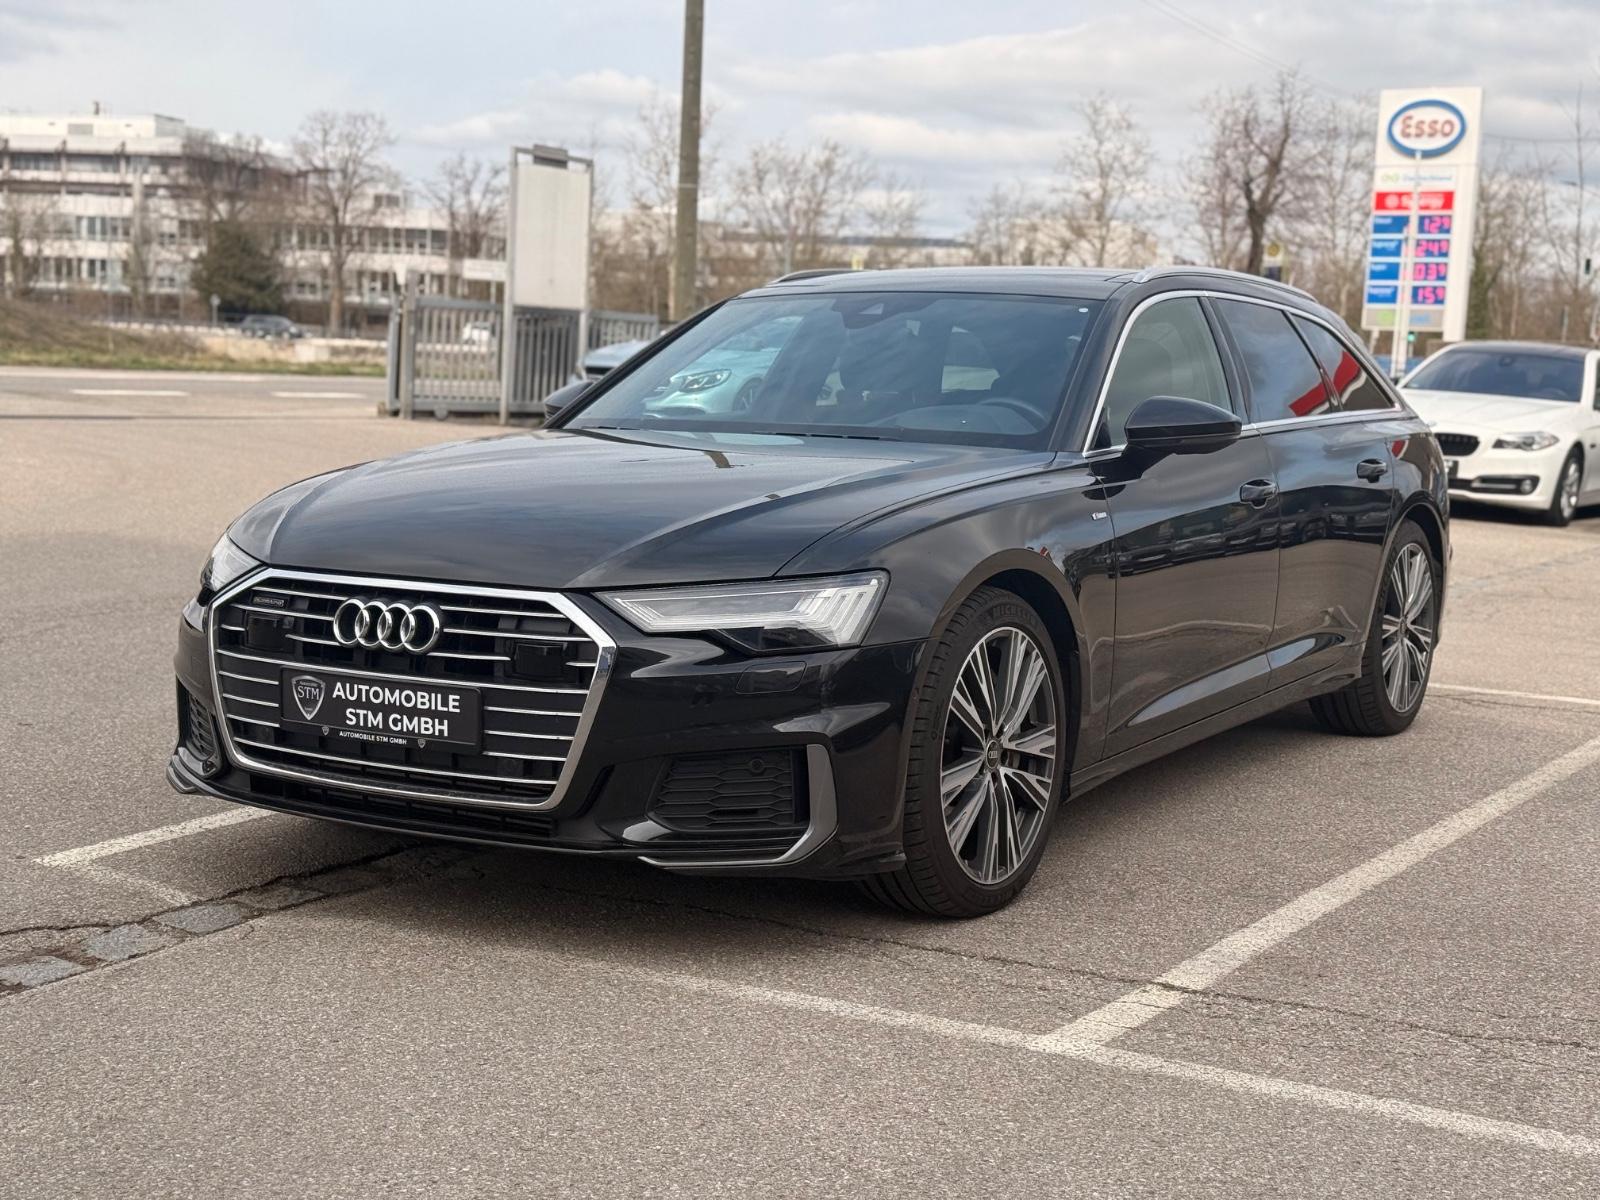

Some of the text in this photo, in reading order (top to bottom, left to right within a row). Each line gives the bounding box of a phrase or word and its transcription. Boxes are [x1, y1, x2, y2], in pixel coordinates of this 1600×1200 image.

[1400, 114, 1455, 138] Esso
[297, 685, 320, 700] STM
[332, 681, 461, 713] AUTOMOBILE
[345, 707, 449, 737] STM GMBH
[339, 730, 408, 746] AUTOMOBILE STM GMBH
